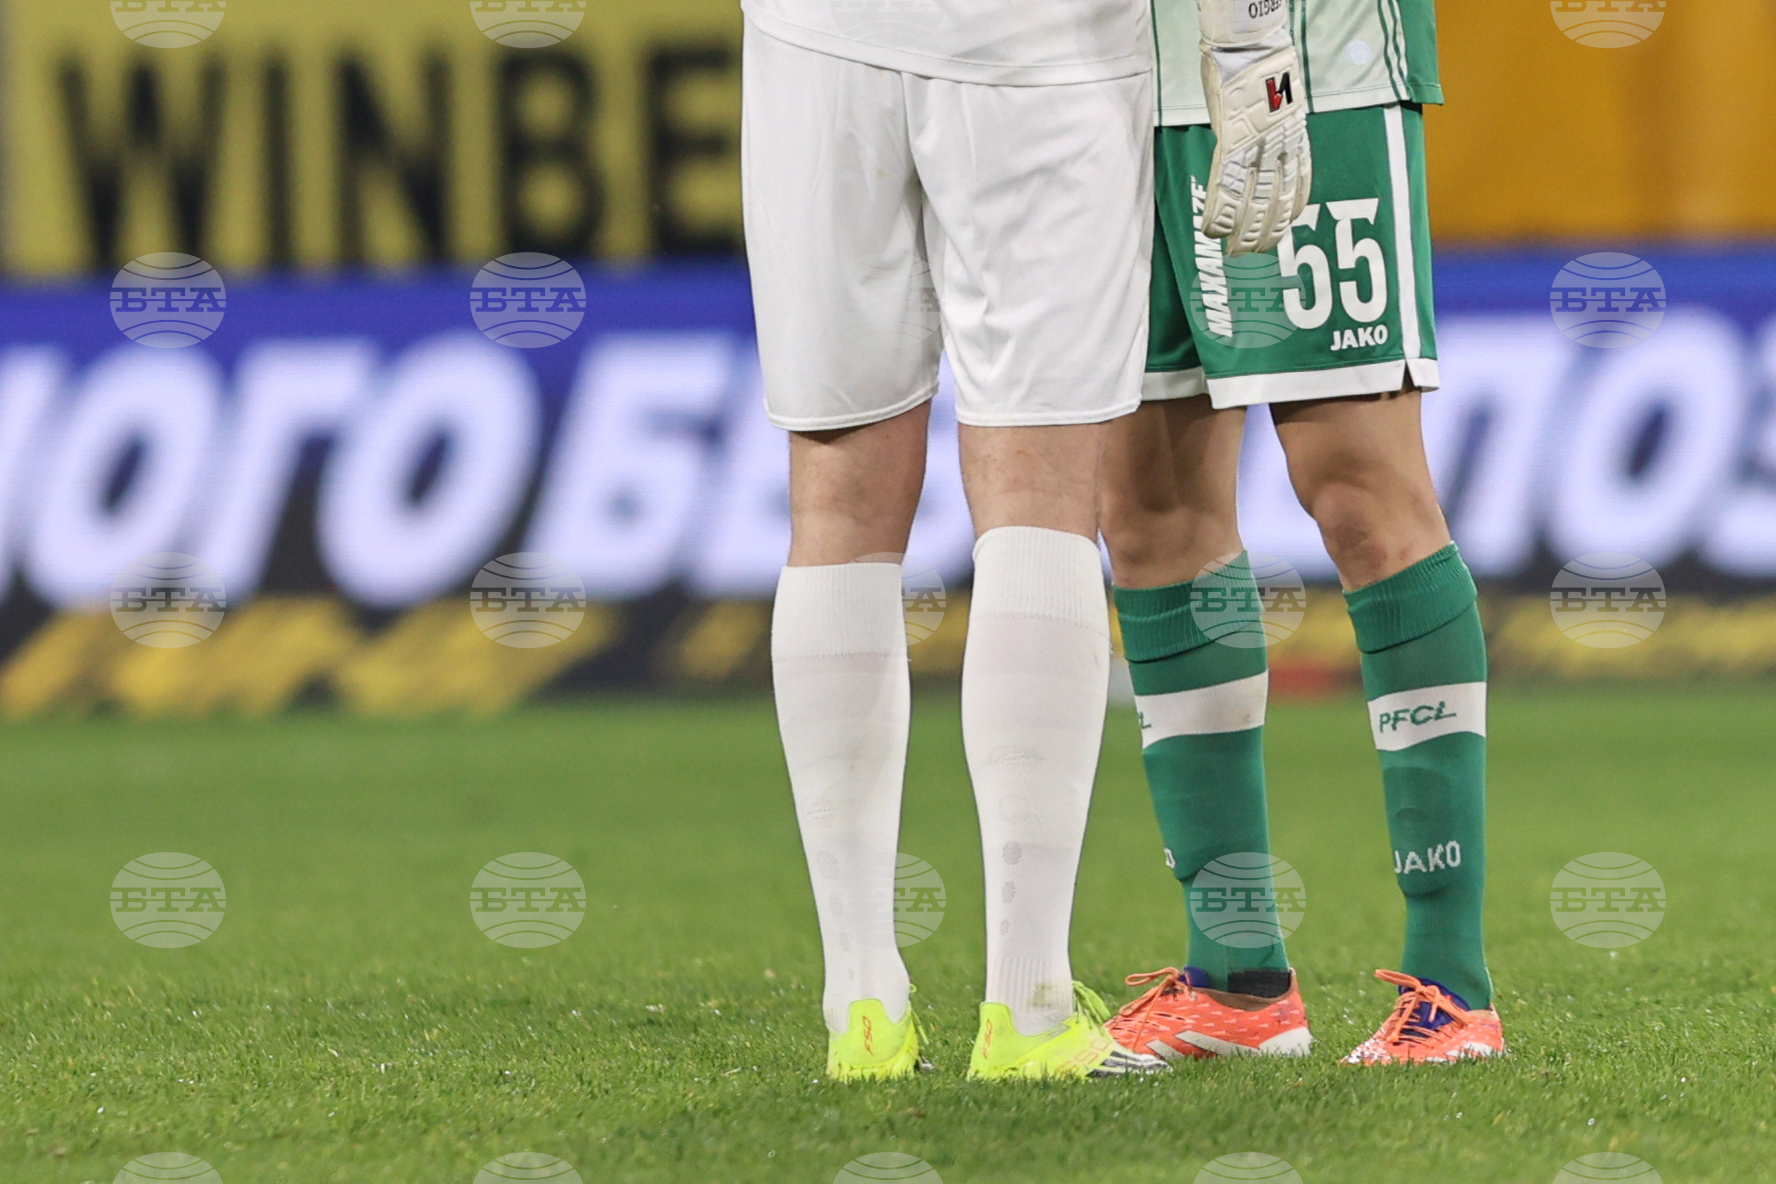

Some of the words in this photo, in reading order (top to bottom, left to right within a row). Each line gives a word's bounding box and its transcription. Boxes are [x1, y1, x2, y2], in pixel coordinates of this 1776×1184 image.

[1277, 198, 1388, 330] 55
[1330, 324, 1389, 351] JAKO
[1379, 700, 1457, 733] PFCL
[1394, 840, 1461, 875] JAKO
